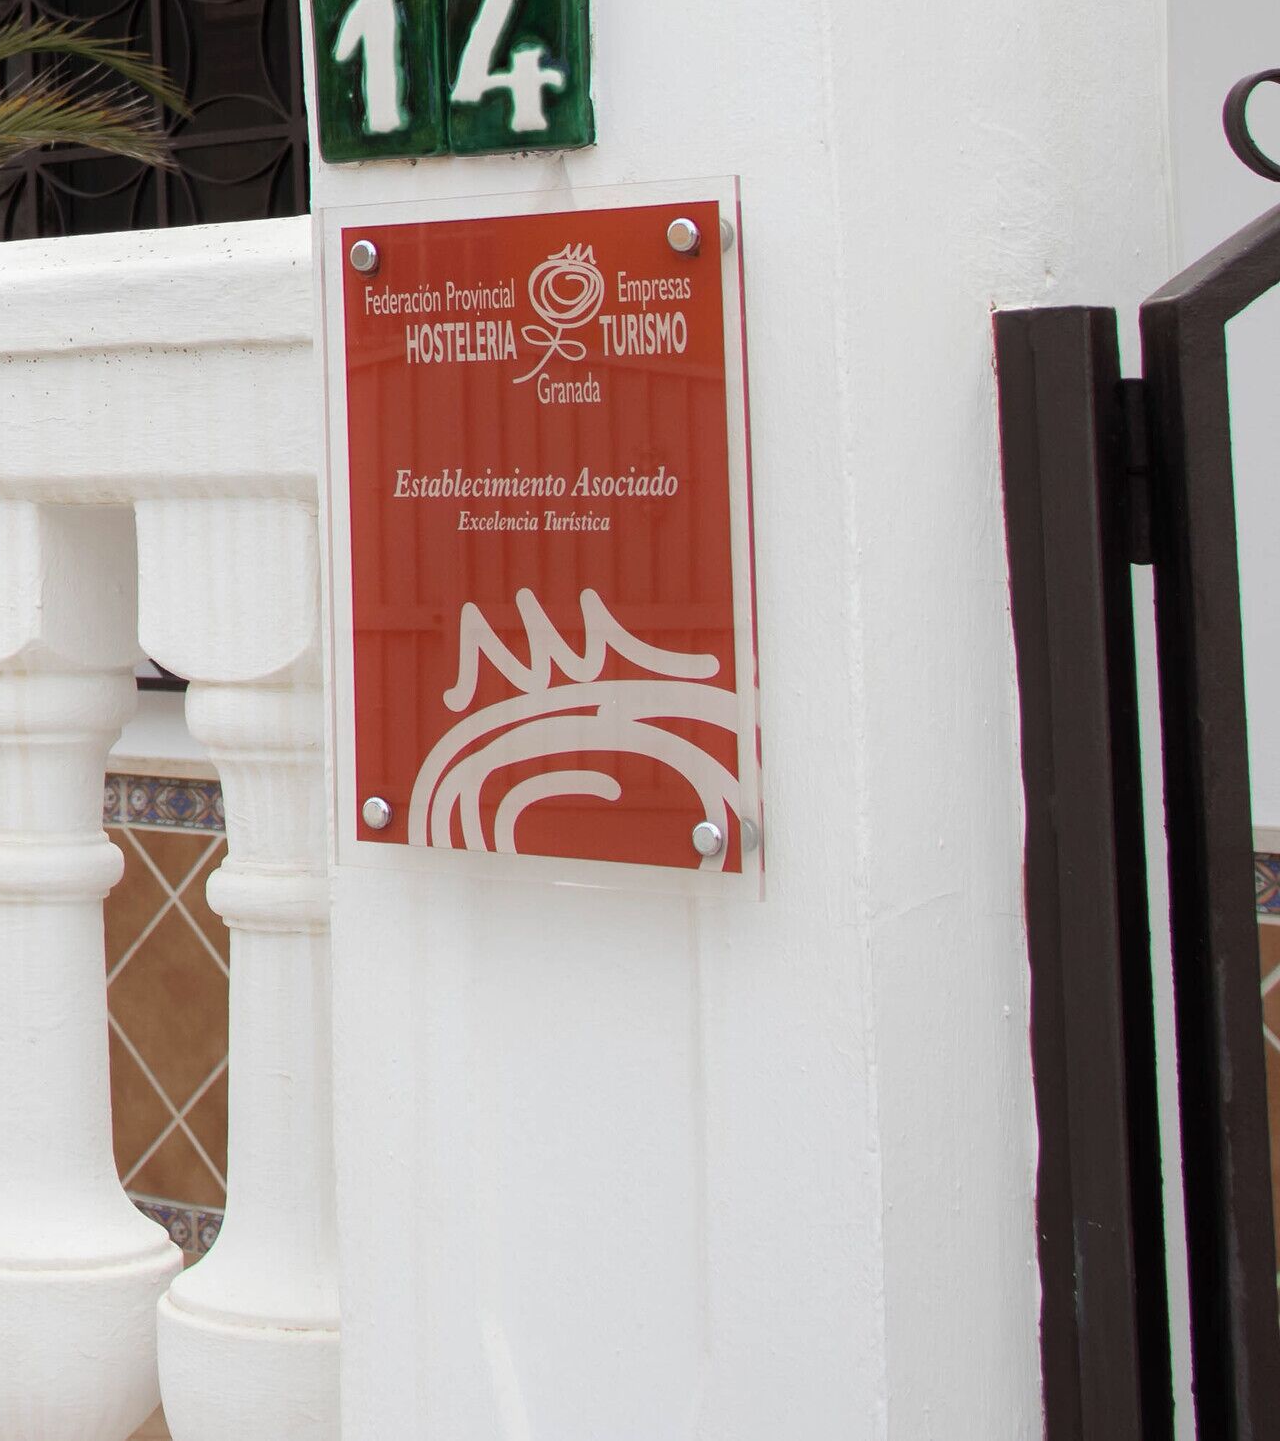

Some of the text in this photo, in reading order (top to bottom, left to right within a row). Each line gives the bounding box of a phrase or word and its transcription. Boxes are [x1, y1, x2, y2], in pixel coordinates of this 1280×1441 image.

[365, 278, 515, 316] Federación Provincial
[617, 271, 692, 311] Empresas
[406, 320, 518, 364] HOSTELERIA
[599, 311, 688, 356] TURISMO
[537, 372, 602, 405] Granada
[394, 465, 679, 498] Establecimiento Asociado
[457, 509, 611, 532] Excelencia Turística
